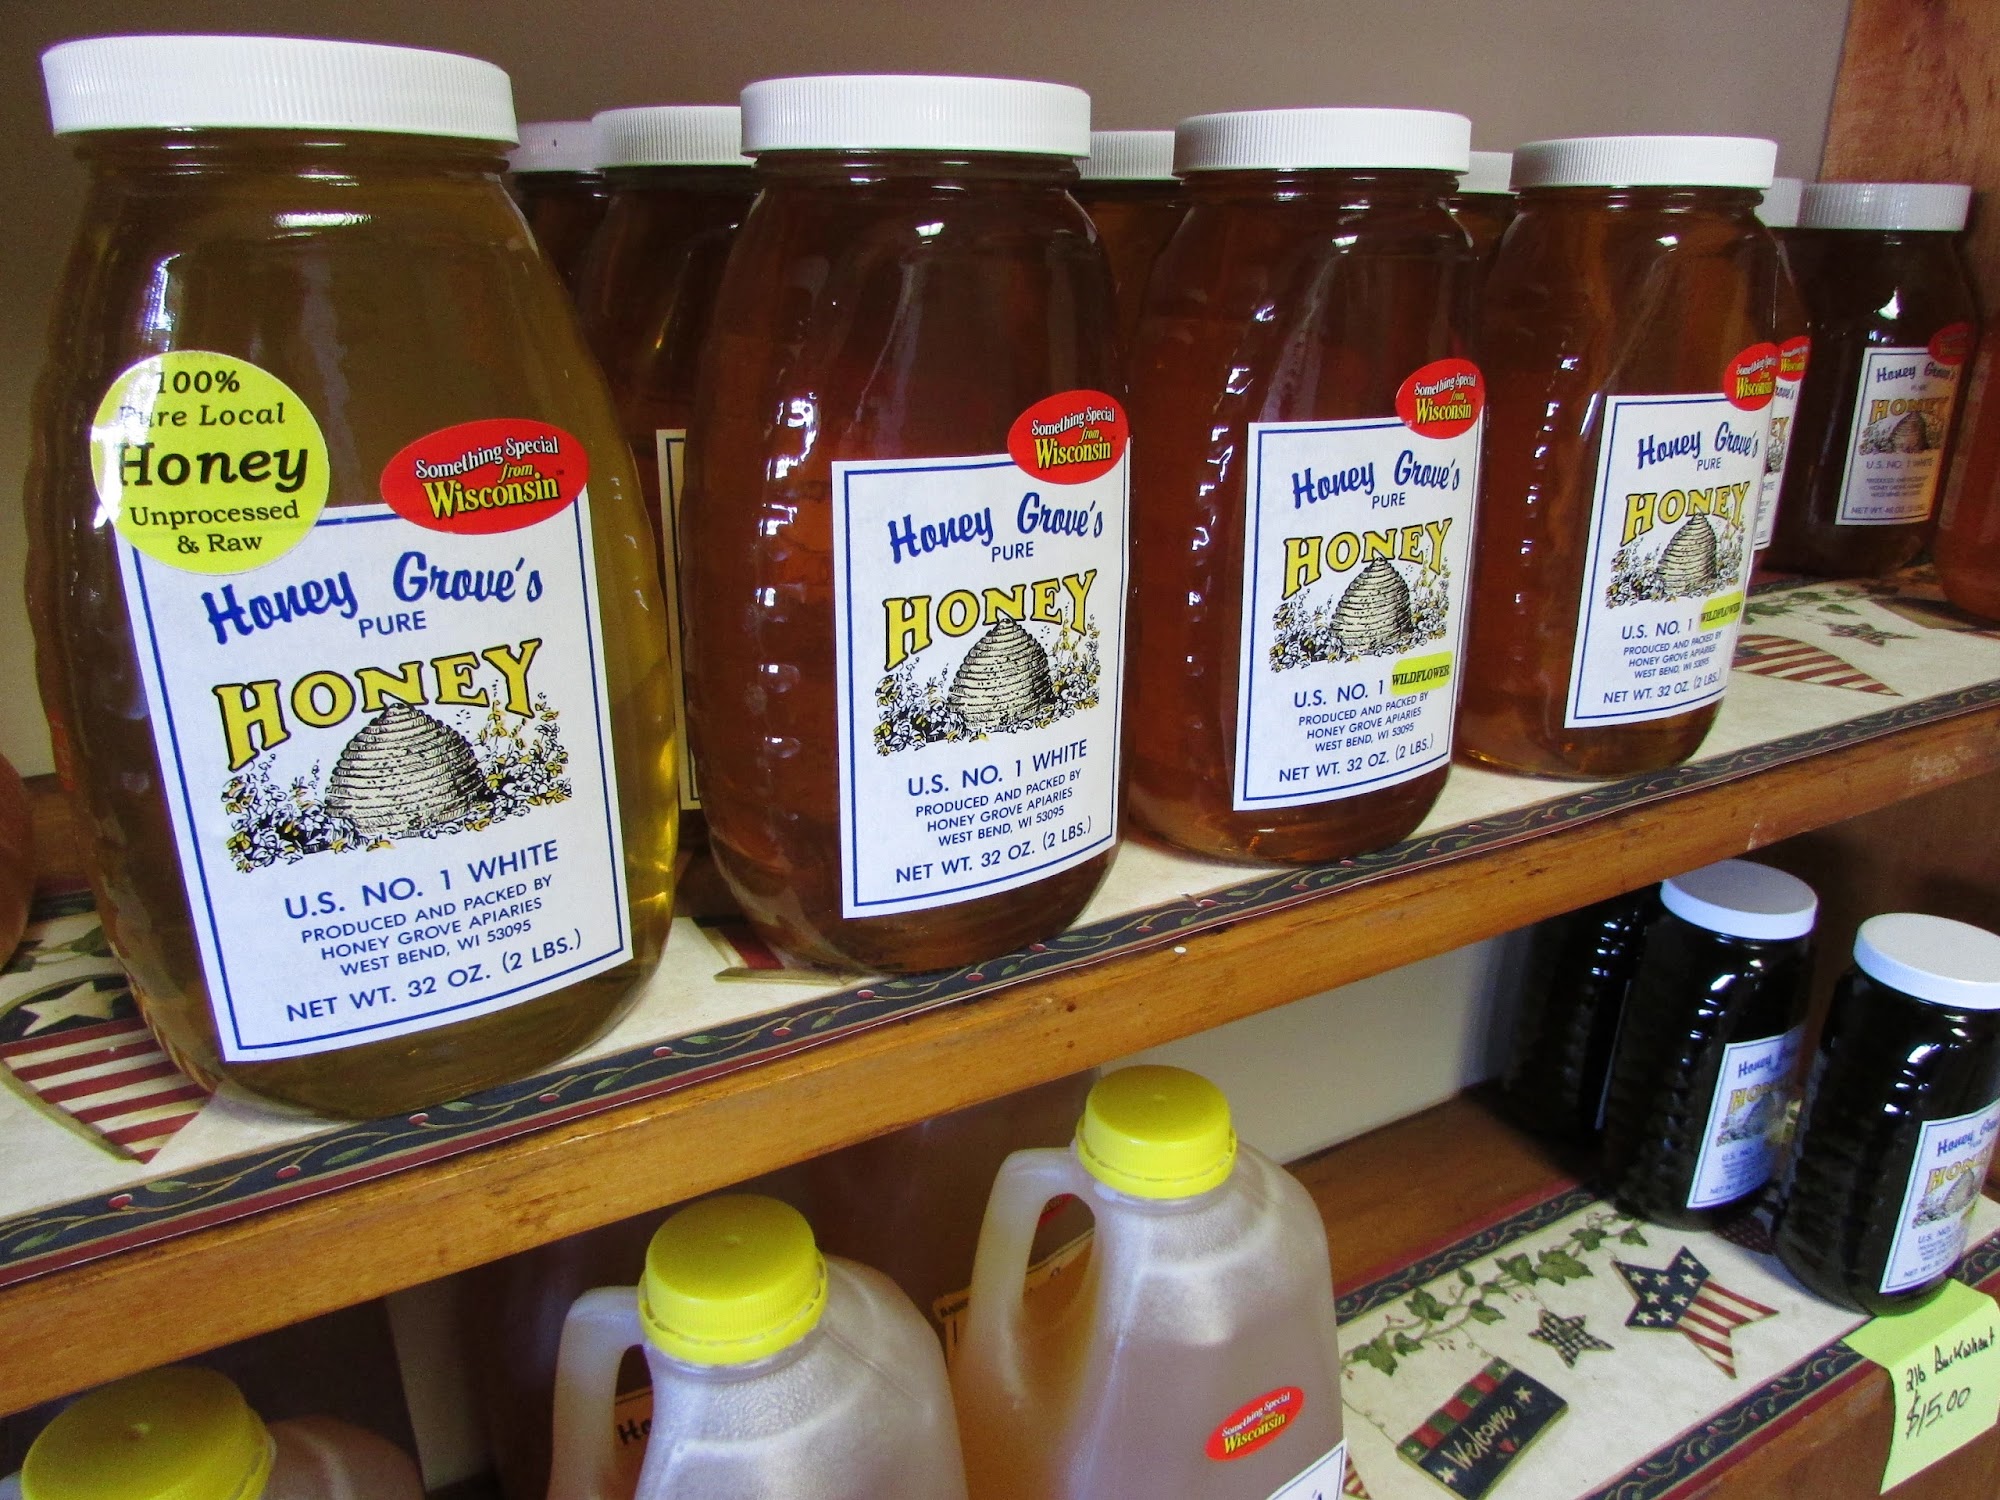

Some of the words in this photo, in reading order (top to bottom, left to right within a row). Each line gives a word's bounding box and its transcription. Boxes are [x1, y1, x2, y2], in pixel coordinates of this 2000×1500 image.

[157, 370, 240, 394] 100%
[1413, 377, 1455, 396] Something
[1455, 372, 1476, 389] Special
[1876, 364, 1916, 383] Honey
[199, 402, 286, 426] Local
[1031, 412, 1085, 436] Something
[1085, 406, 1115, 425] Special
[1415, 398, 1472, 424] Wisconsin
[1034, 436, 1111, 469] Wisconsin
[1079, 426, 1100, 444] from
[1637, 430, 1701, 470] Honey
[1714, 421, 1759, 458] Grove's
[118, 442, 308, 493] Honey
[415, 446, 504, 479] Something
[505, 436, 559, 459] Special
[497, 462, 533, 483] from
[1697, 457, 1722, 471] PURE
[422, 472, 559, 519] Wisconsin
[1291, 461, 1375, 509] Honey
[1393, 449, 1460, 491] Grove's
[129, 499, 300, 530] Unprocessed
[1371, 492, 1406, 509] PURE
[1620, 480, 1750, 548] HONEY
[177, 535, 200, 554] &
[207, 533, 263, 553] Raw
[887, 507, 994, 564] Honey
[1017, 492, 1104, 539] Grove's
[991, 541, 1034, 562] PURE
[1281, 517, 1453, 600] HONEY
[201, 571, 359, 645] Honey
[393, 551, 543, 602] Grove's
[358, 610, 427, 638] PURE
[881, 568, 1098, 673] HONEY
[1621, 624, 1648, 640] U.S.
[1655, 620, 1680, 637] NO.
[1688, 618, 1693, 631] 1
[1623, 643, 1670, 655] PRODUCED
[1672, 639, 1690, 650] AND
[1714, 630, 1724, 640] BY
[1628, 656, 1660, 668] HONEY
[1662, 651, 1689, 664] GROVE
[1294, 689, 1327, 708] U.S.
[1336, 683, 1369, 703] NO.
[1378, 679, 1384, 695] 1
[1391, 664, 1450, 686] WILDFLOWER
[1603, 691, 1628, 704] NET
[1633, 687, 1653, 701] WT.
[1657, 685, 1671, 698] 32
[1674, 681, 1690, 695] OZ.
[1634, 669, 1657, 679] WEST
[211, 638, 543, 772] HONEY
[1298, 709, 1357, 726] PRODUCED
[1360, 704, 1382, 717] AND
[1385, 694, 1417, 712] PACKED
[1419, 691, 1429, 702] BY
[1306, 724, 1346, 740] HONEY
[1348, 717, 1383, 733] GROVE
[1385, 706, 1422, 725] APIARIES
[1279, 766, 1310, 782] NET
[1316, 761, 1340, 777] WT.
[1346, 757, 1363, 772] 32
[1367, 751, 1390, 767] OZ.
[1395, 743, 1406, 761] (2
[1410, 733, 1434, 756] LBS.)
[1314, 739, 1343, 752] WEST
[1345, 734, 1374, 748] BEND,
[1377, 729, 1389, 741] WI
[1391, 722, 1414, 737] 53095
[908, 774, 949, 796] U.S.
[962, 764, 1003, 788] NO.
[1015, 760, 1021, 777] 1
[1032, 739, 1087, 772] WHITE
[915, 795, 989, 818] PRODUCED
[994, 787, 1021, 804] AND
[1025, 774, 1065, 796] PACKED
[1069, 768, 1081, 781] BY
[927, 813, 976, 833] HONEY
[980, 803, 1023, 823] GROVE
[1026, 787, 1073, 811] APIARIES
[938, 830, 973, 847] WEST
[977, 823, 1013, 840] BEND,
[1018, 816, 1032, 829] WI
[1035, 805, 1065, 824] 53095
[896, 863, 934, 884] NET
[941, 856, 973, 876] WT.
[981, 850, 1000, 868] 32
[1007, 840, 1035, 860] OZ.
[1042, 831, 1056, 850] (2
[1061, 815, 1092, 843] LBS.)
[284, 891, 345, 919] U.S.
[361, 877, 423, 907] NO.
[440, 869, 451, 890] 1
[467, 839, 559, 883] WHITE
[301, 912, 407, 943] PRODUCED
[414, 902, 456, 923] AND
[463, 883, 527, 911] PACKED
[534, 874, 553, 891] BY
[321, 936, 390, 960] HONEY
[397, 920, 462, 945] GROVE
[468, 897, 543, 930] APIARIES
[340, 955, 390, 976] WEST
[398, 943, 451, 965] BEND,
[457, 934, 481, 951] WI
[487, 919, 532, 943] 53095
[286, 996, 338, 1022] NET
[349, 985, 397, 1010] WT.
[407, 975, 437, 998] 32
[447, 963, 491, 988] OZ.
[502, 950, 523, 974] (2
[531, 928, 582, 963] LBS.)
[1738, 1055, 1772, 1079] Honey
[1937, 1131, 1974, 1157] Honey
[1222, 1407, 1263, 1437] Something
[1264, 1392, 1290, 1411] Special
[1223, 1413, 1286, 1453] Wisconsin
[1906, 1386, 1971, 1439] $15.00
[1440, 1405, 1517, 1471] Welcome
